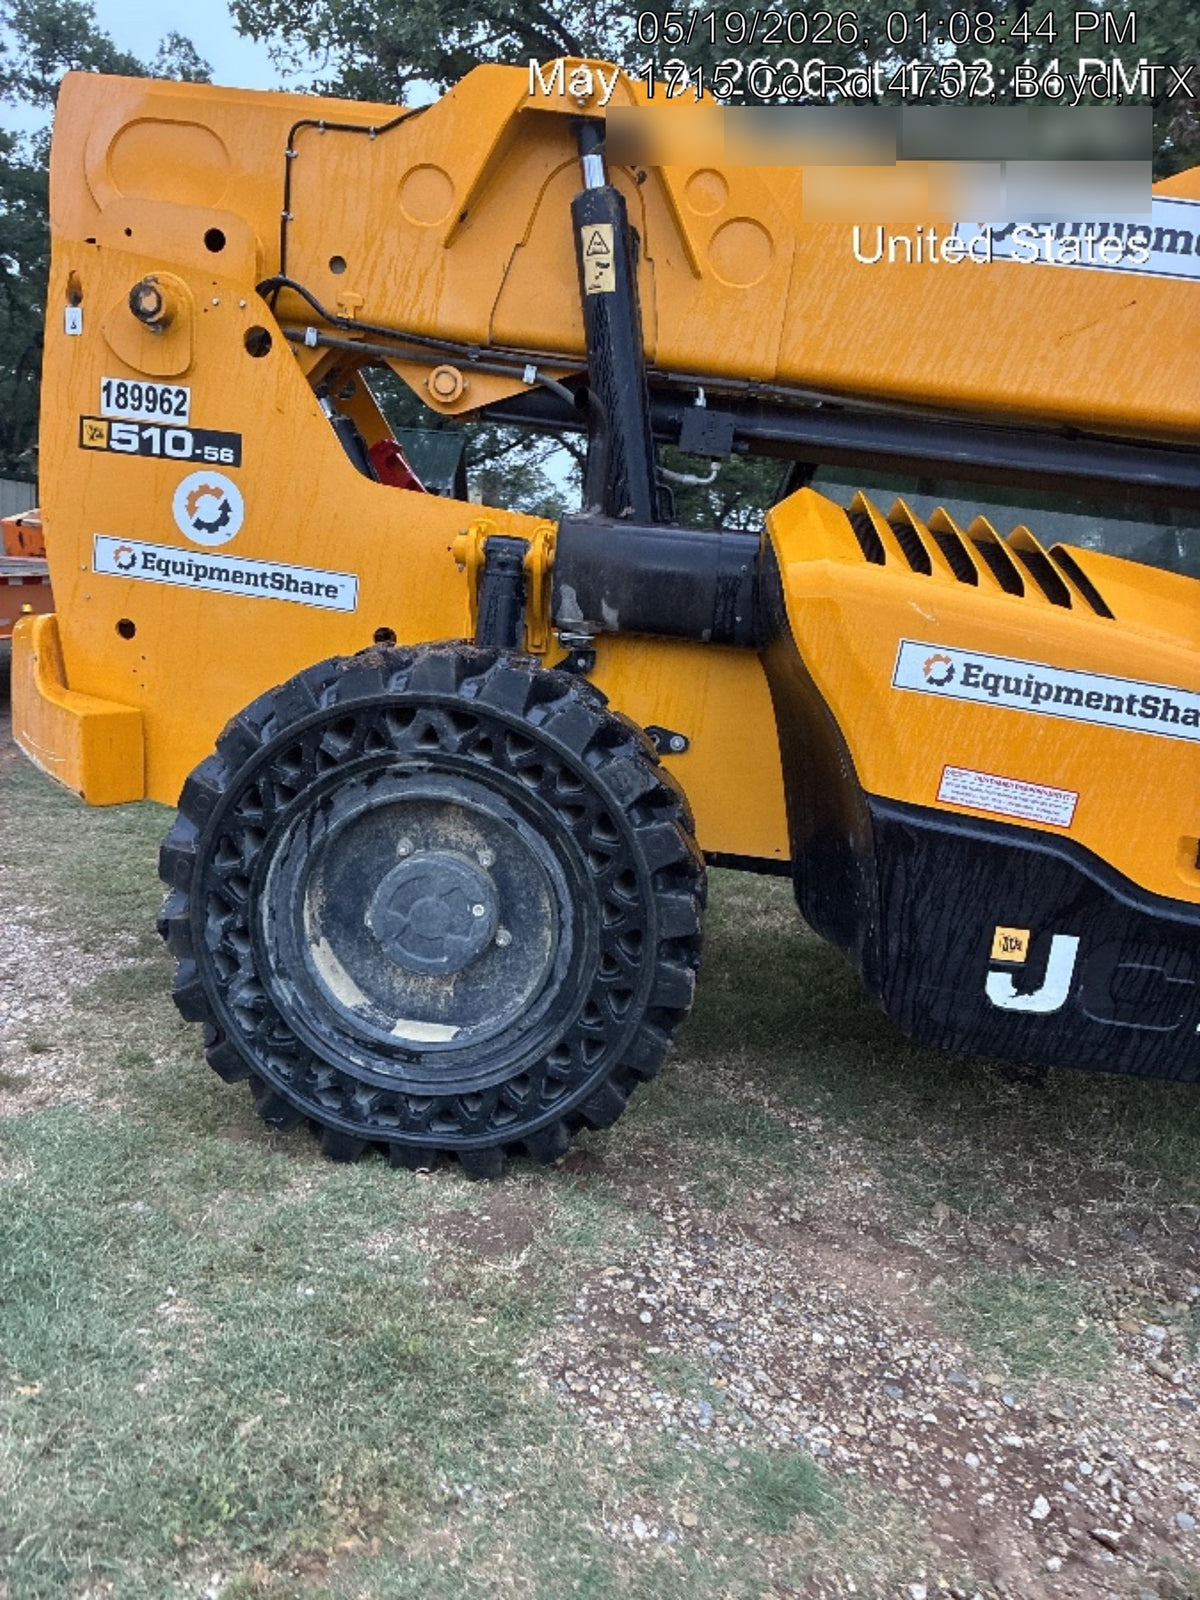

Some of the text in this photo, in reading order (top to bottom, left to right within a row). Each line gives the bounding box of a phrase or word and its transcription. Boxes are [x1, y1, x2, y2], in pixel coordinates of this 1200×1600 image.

[102, 379, 188, 417] 189962
[109, 421, 235, 464] 510-56
[141, 550, 339, 600] EquipmentShare
